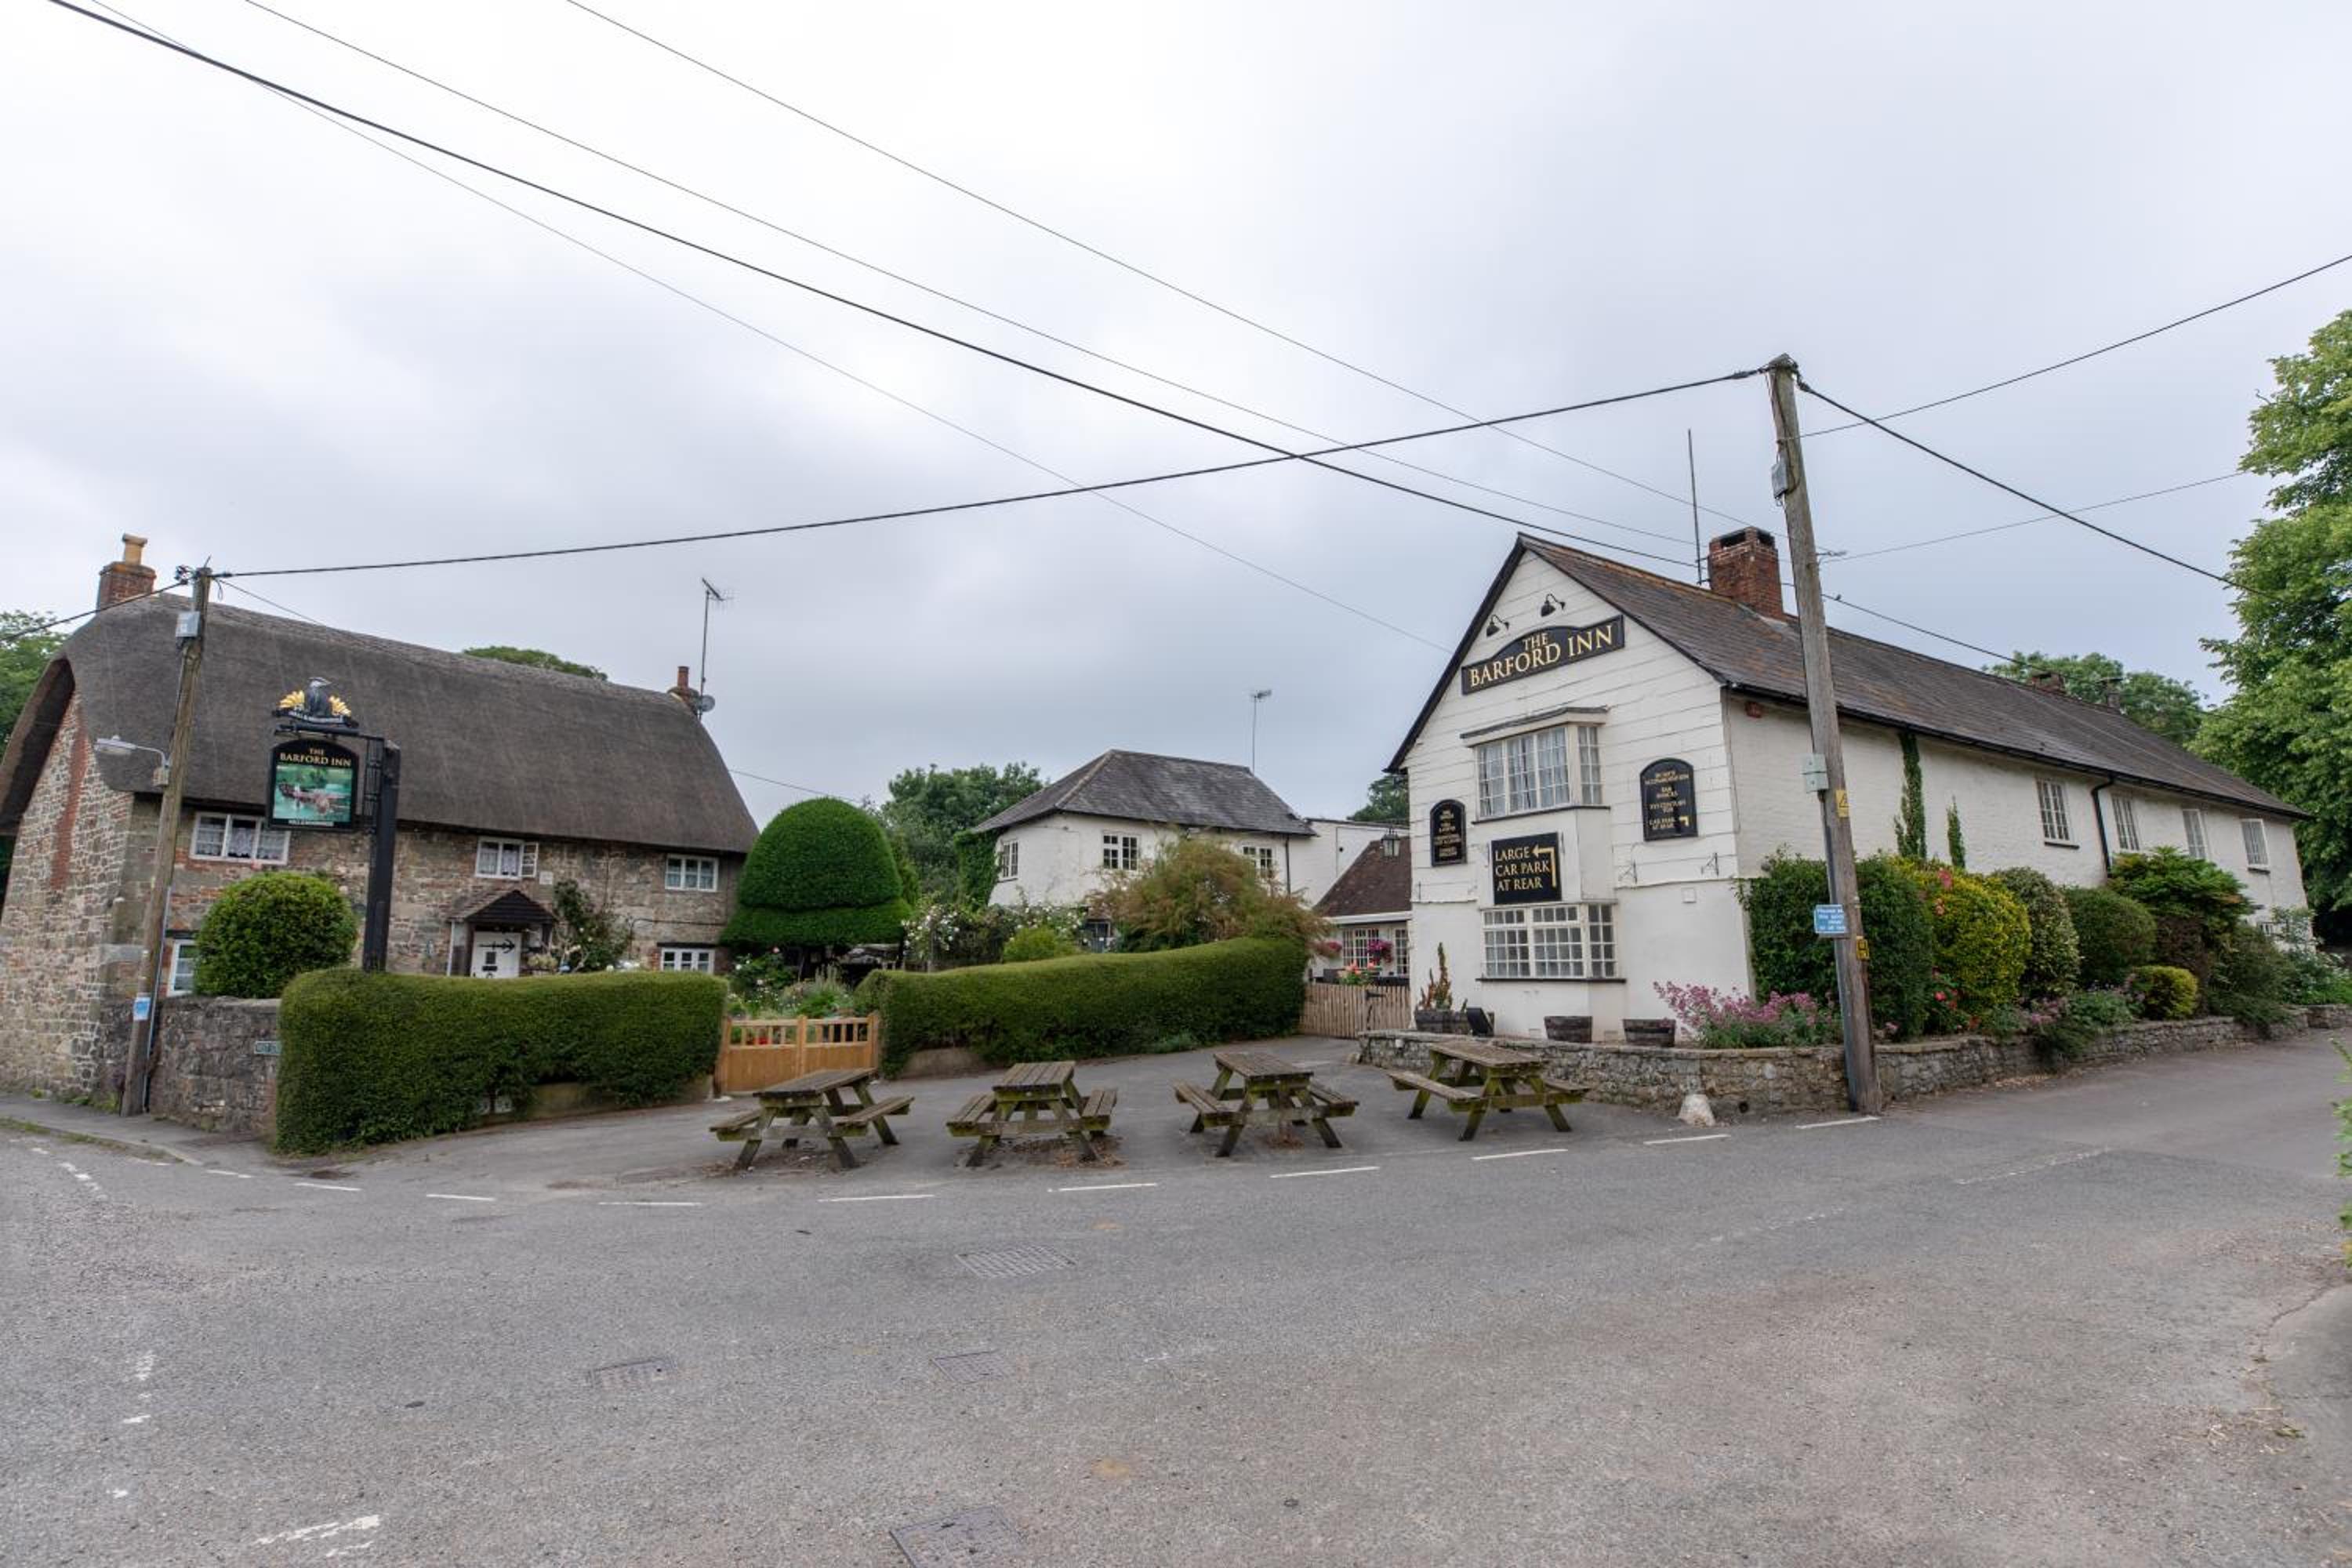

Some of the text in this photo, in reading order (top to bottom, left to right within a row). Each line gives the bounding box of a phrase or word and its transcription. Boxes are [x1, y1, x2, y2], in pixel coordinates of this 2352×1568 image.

[1523, 633, 1548, 651] THE
[1470, 625, 1613, 687] BARFORD INN
[280, 753, 328, 764] BARFORD
[1495, 847, 1530, 862] LARGE
[1495, 860, 1550, 877] CAR PARK
[1497, 877, 1543, 891] AT REAR
